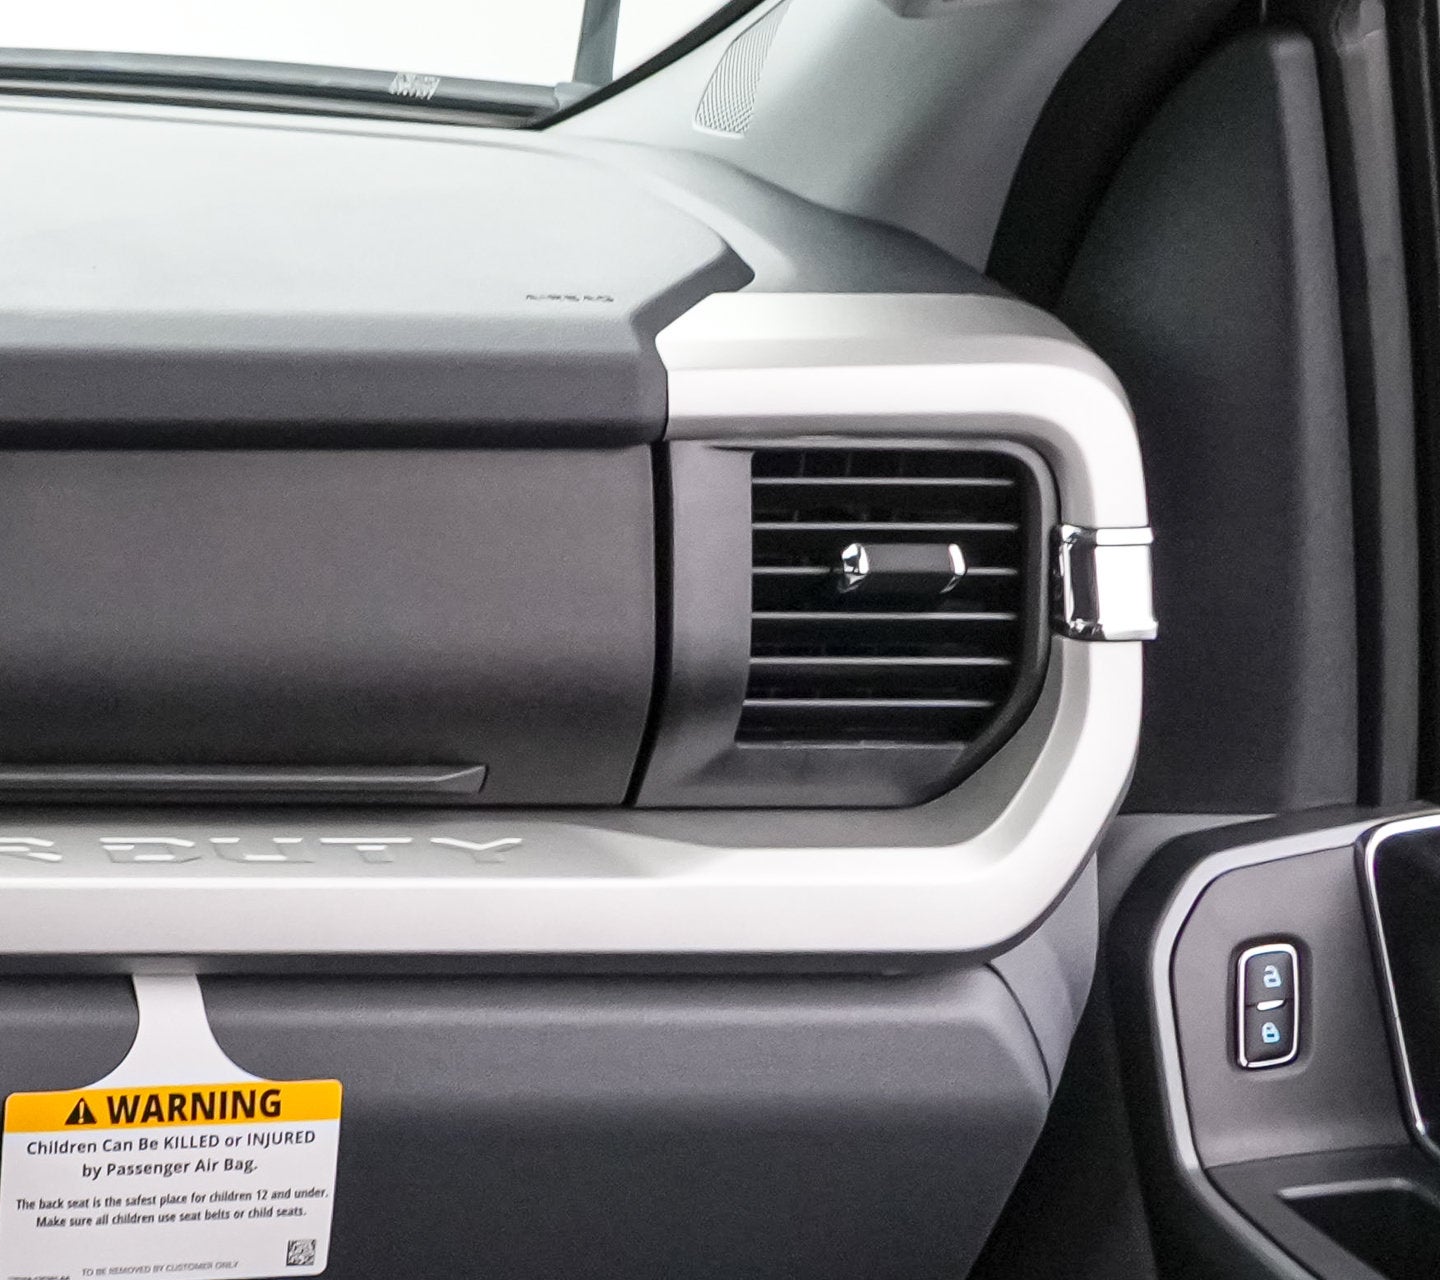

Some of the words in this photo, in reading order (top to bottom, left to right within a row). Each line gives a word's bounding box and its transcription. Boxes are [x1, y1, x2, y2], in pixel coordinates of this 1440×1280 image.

[99, 835, 523, 864] DUTY
[107, 1089, 281, 1125] WARNING
[26, 1139, 97, 1155] Children
[102, 1138, 133, 1152] Can
[138, 1137, 158, 1151] Be
[164, 1134, 219, 1150] KILLED
[225, 1136, 242, 1147] or
[247, 1130, 316, 1149] INJURED
[82, 1163, 102, 1181] by
[107, 1160, 191, 1178] Passenger
[194, 1158, 219, 1173] Air
[224, 1158, 258, 1174] Bag.
[16, 1198, 35, 1210] The
[39, 1197, 64, 1210] back
[67, 1198, 89, 1209] seat
[92, 1196, 101, 1208] is
[105, 1196, 121, 1207] the
[125, 1194, 156, 1207] safest
[160, 1193, 187, 1209] place
[191, 1191, 206, 1204] for
[209, 1190, 252, 1203] children
[256, 1189, 268, 1200] 12
[271, 1188, 291, 1199] and
[36, 1216, 66, 1228] Make
[69, 1217, 92, 1227] sure
[95, 1214, 109, 1225] all
[111, 1213, 154, 1225] children
[158, 1214, 176, 1223] use
[179, 1210, 201, 1221] seat
[204, 1208, 230, 1220] belts
[233, 1209, 245, 1219] or
[248, 1206, 273, 1218] child
